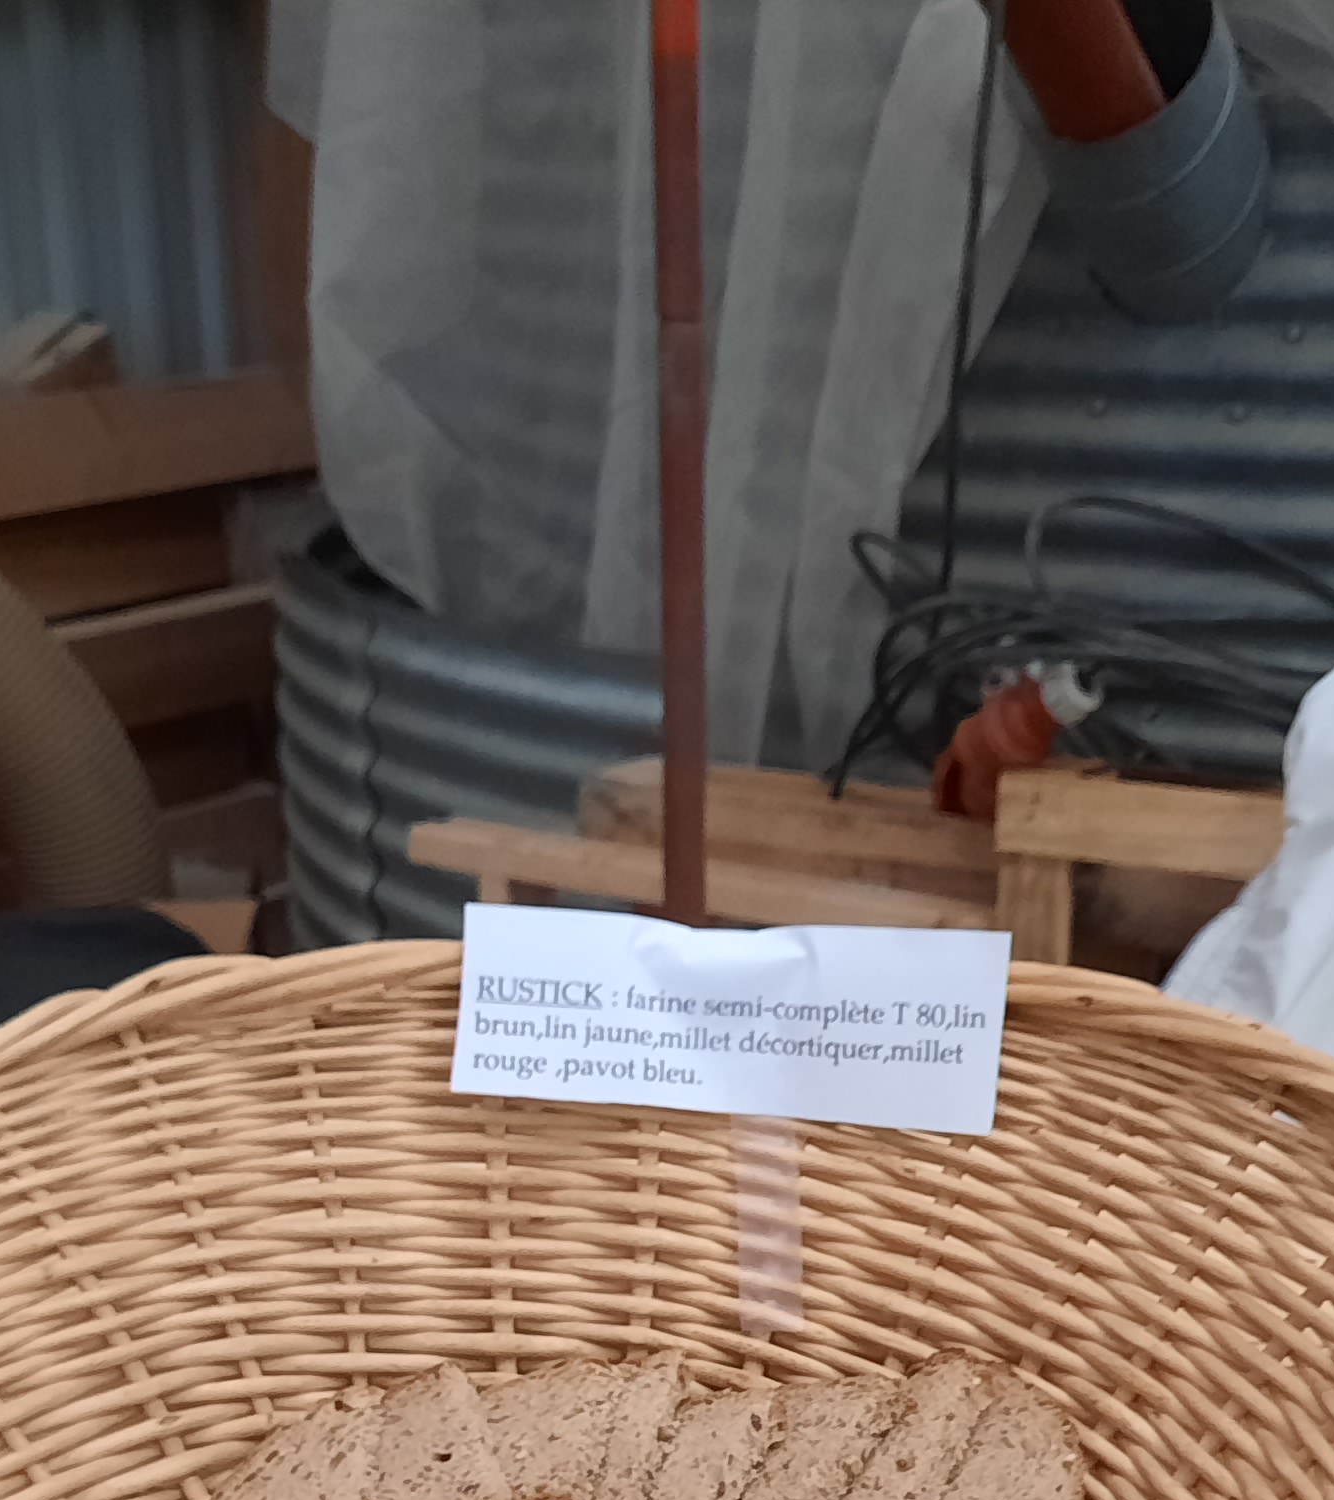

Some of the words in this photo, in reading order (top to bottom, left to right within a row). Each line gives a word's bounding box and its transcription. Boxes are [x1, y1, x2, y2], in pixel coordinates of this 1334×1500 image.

[476, 975, 603, 1010] RUSTICK
[626, 984, 696, 1015] farine
[703, 996, 885, 1030] semi-complète
[892, 1001, 911, 1025] T
[916, 1002, 986, 1031] 80,lin
[474, 1011, 576, 1041] brun,lin
[583, 1017, 731, 1052] jaune,millet
[473, 1053, 548, 1080] rouge
[643, 1057, 703, 1085] bleu.
